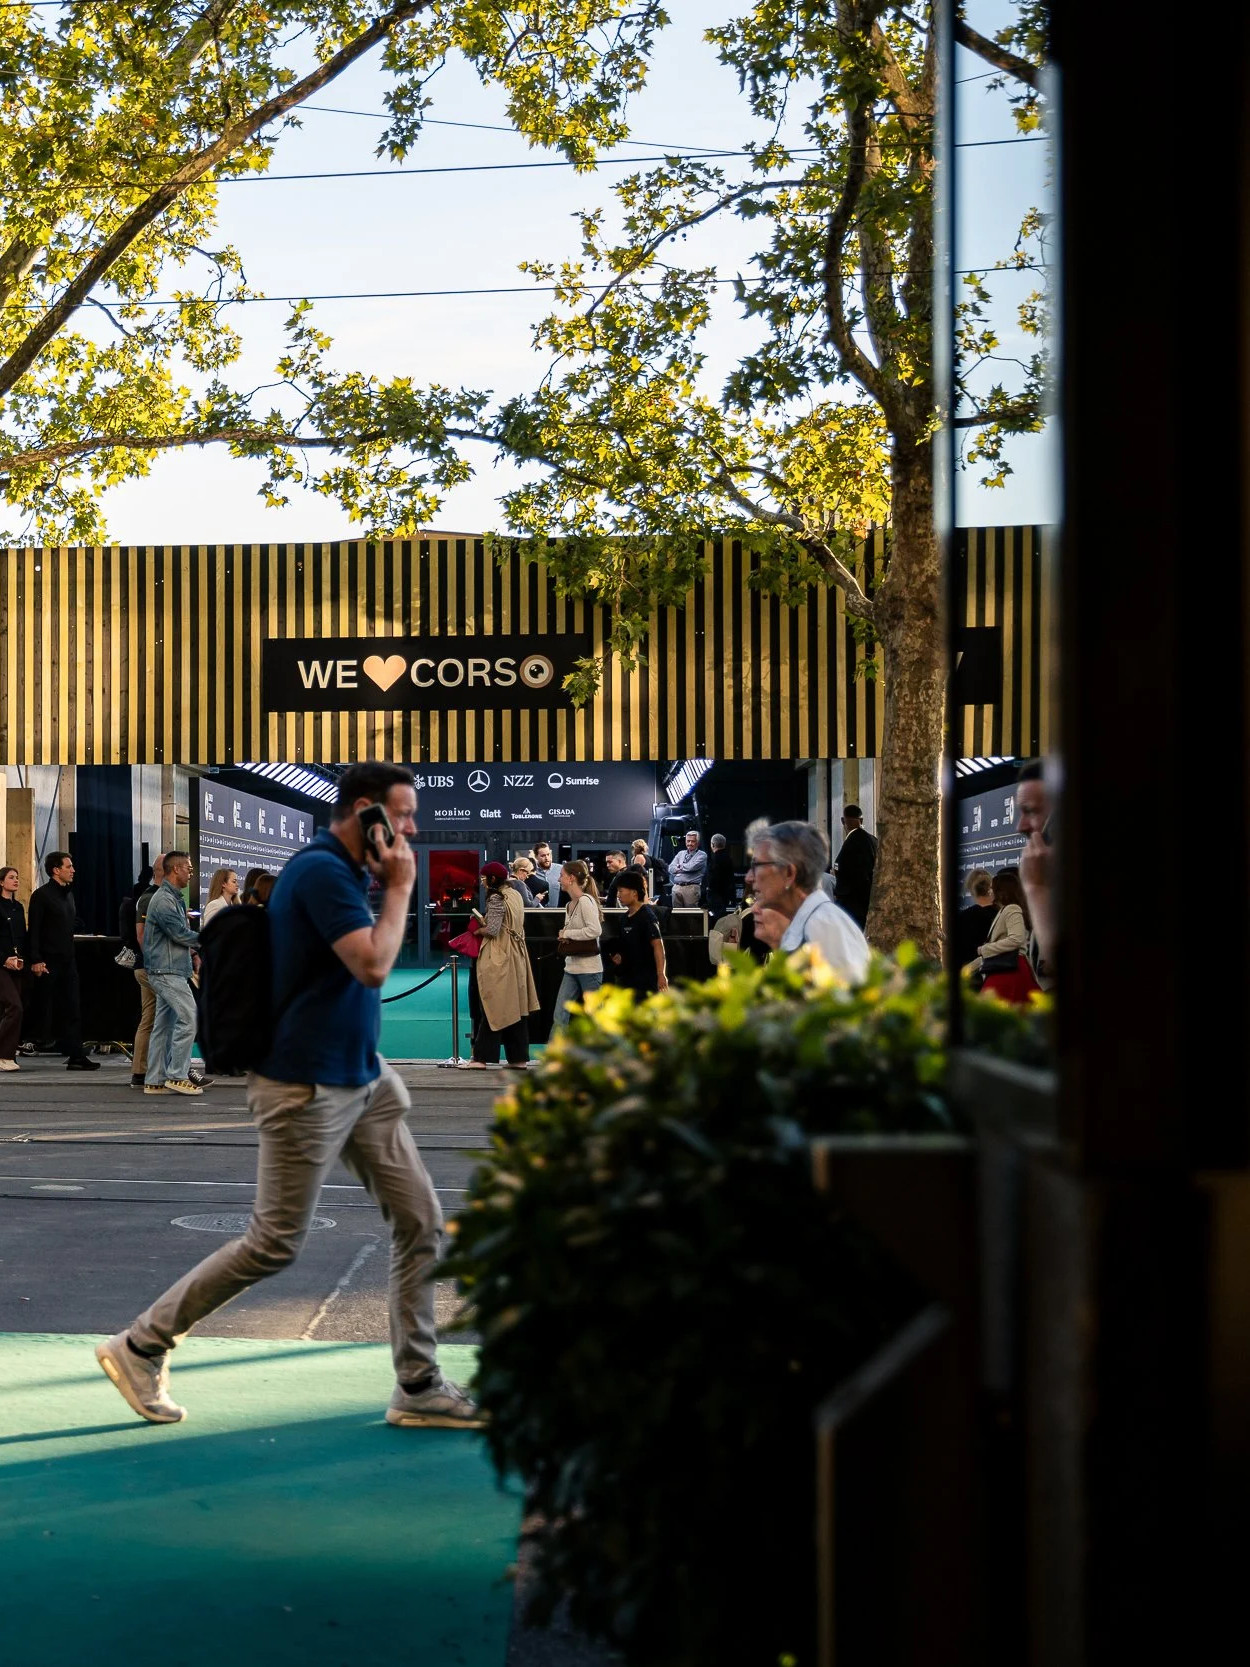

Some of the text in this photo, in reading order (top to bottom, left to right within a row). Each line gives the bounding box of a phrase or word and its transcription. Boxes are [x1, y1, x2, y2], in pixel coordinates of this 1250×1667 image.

[297, 654, 554, 689] WE CORSO
[427, 775, 454, 788] UBS
[503, 775, 534, 787] NZZ
[565, 776, 600, 786] Sunrise
[480, 809, 502, 818] Glatt
